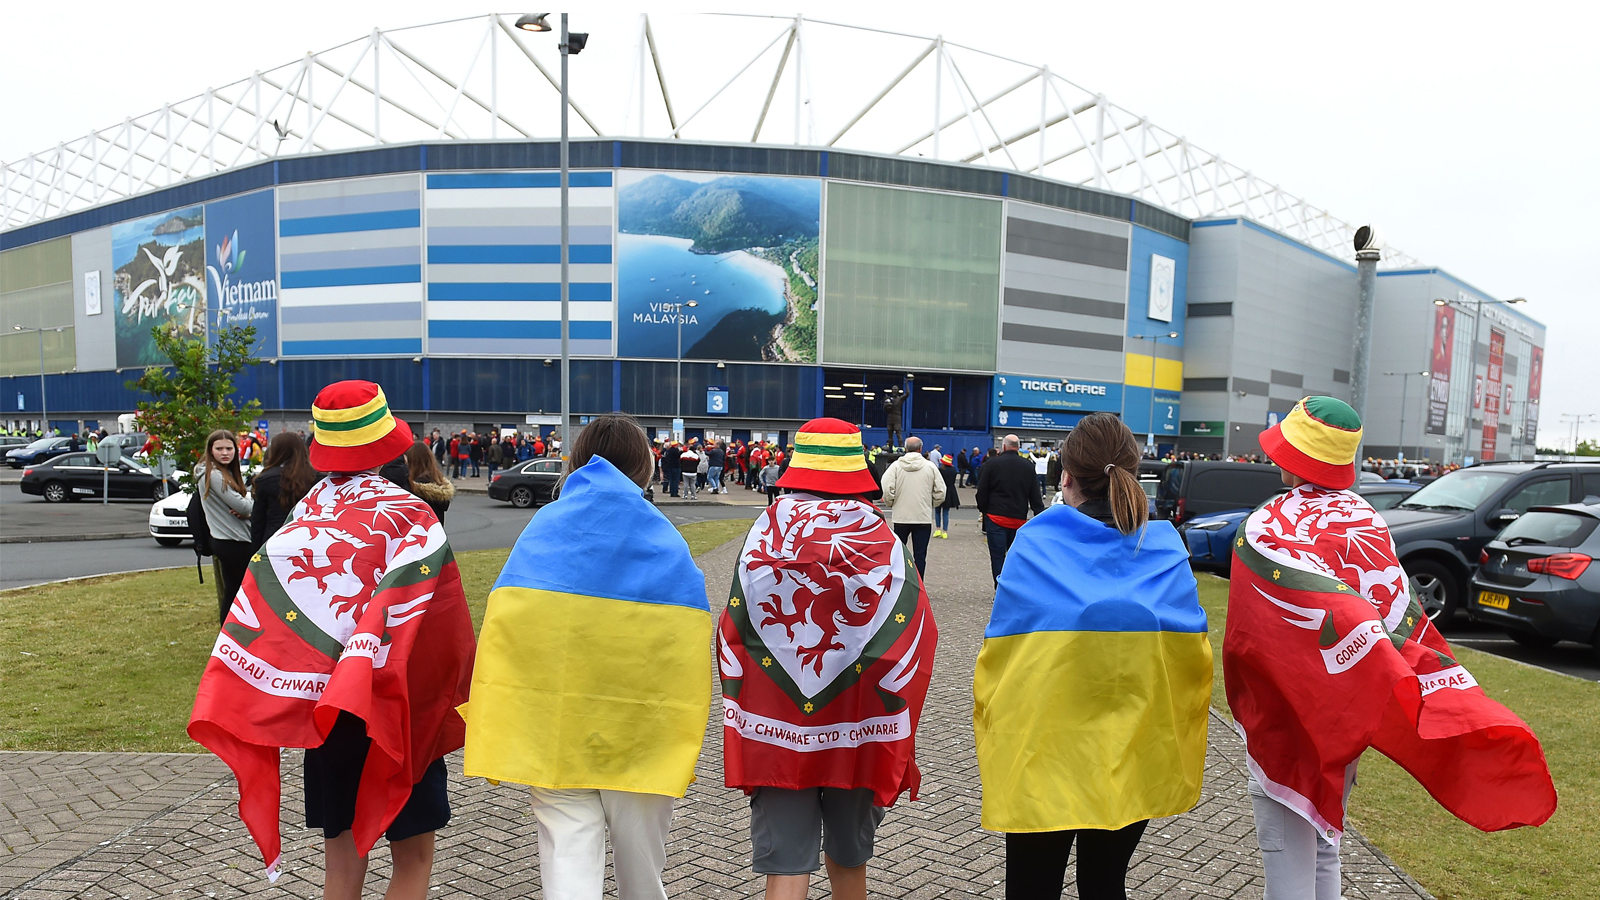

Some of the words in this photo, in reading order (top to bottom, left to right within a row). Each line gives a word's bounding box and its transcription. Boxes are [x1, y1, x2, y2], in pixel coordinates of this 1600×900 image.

[121, 258, 198, 334] Turkey
[206, 265, 278, 328] Vietnam
[633, 313, 698, 325] MALAYSIA
[1020, 379, 1062, 392] TICKET
[1065, 383, 1106, 395] OFFICE
[712, 395, 724, 411] 3
[1167, 405, 1174, 419] 2
[1335, 633, 1368, 665] GORAU
[218, 643, 266, 680] GORAU
[754, 723, 811, 746] CHWARAE
[817, 730, 840, 744] CYD
[849, 722, 899, 742] CHWARAE
